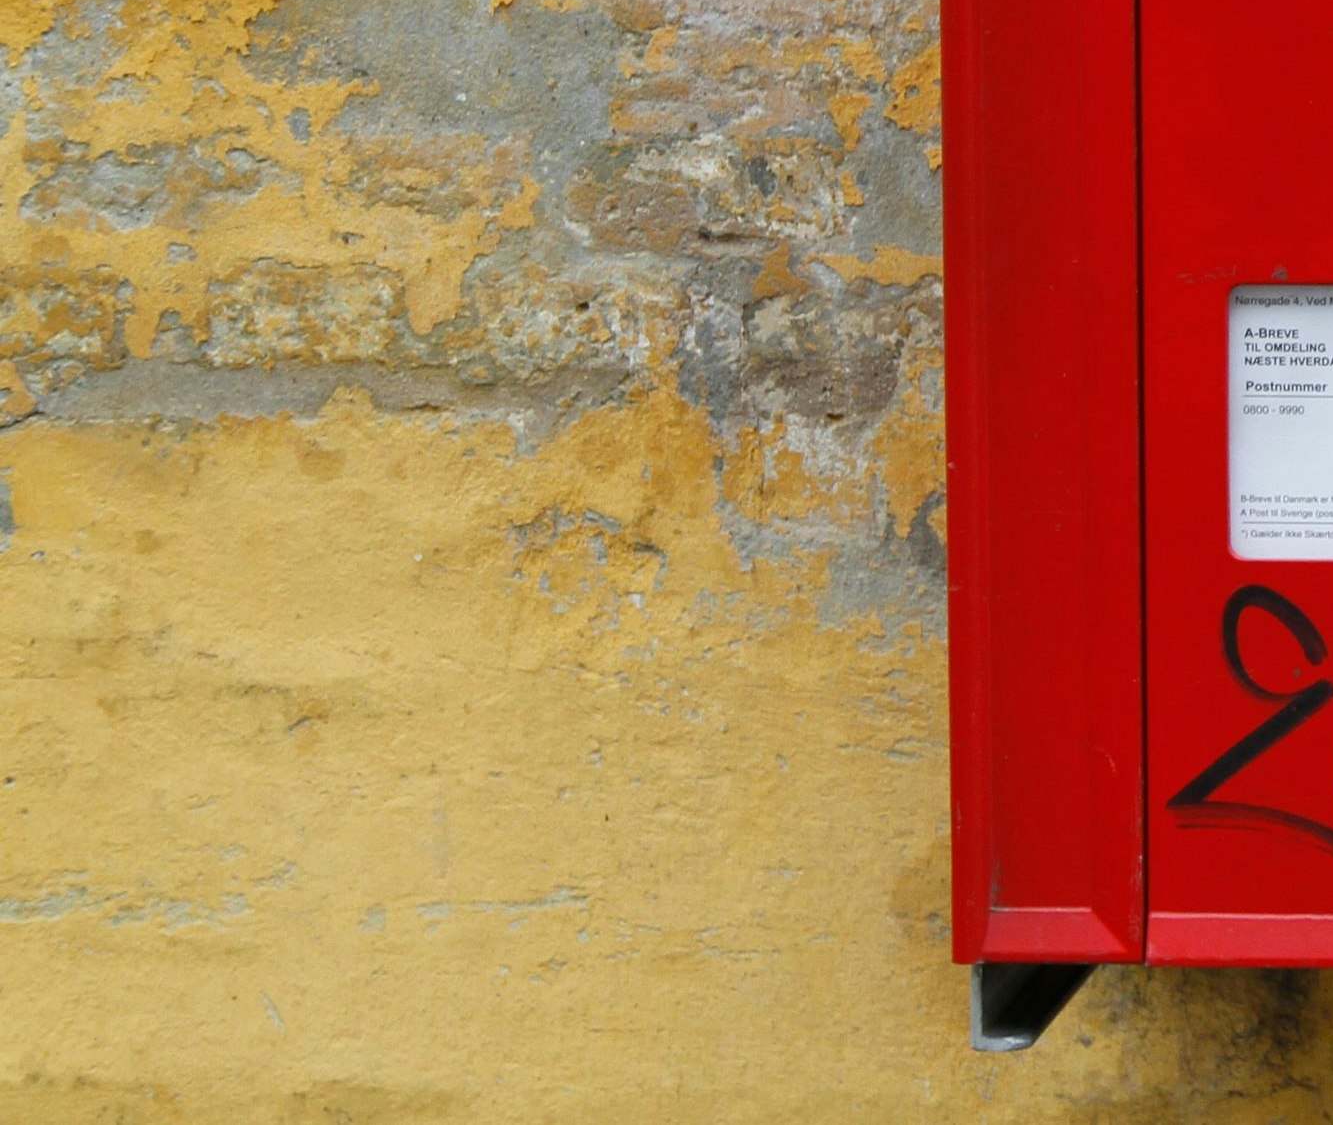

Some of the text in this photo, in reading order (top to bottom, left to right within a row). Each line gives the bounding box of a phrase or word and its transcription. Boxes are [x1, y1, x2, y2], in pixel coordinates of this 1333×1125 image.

[1235, 296, 1290, 307] Nørregade
[1293, 297, 1303, 306] 4,
[1306, 297, 1326, 306] Ved
[1245, 328, 1299, 338] A-BREVE
[1245, 343, 1326, 352] TIL OMDELING
[1245, 357, 1286, 366] NÆSTE
[1246, 382, 1327, 393] Postnummer
[1243, 406, 1305, 415] 0800 9990
